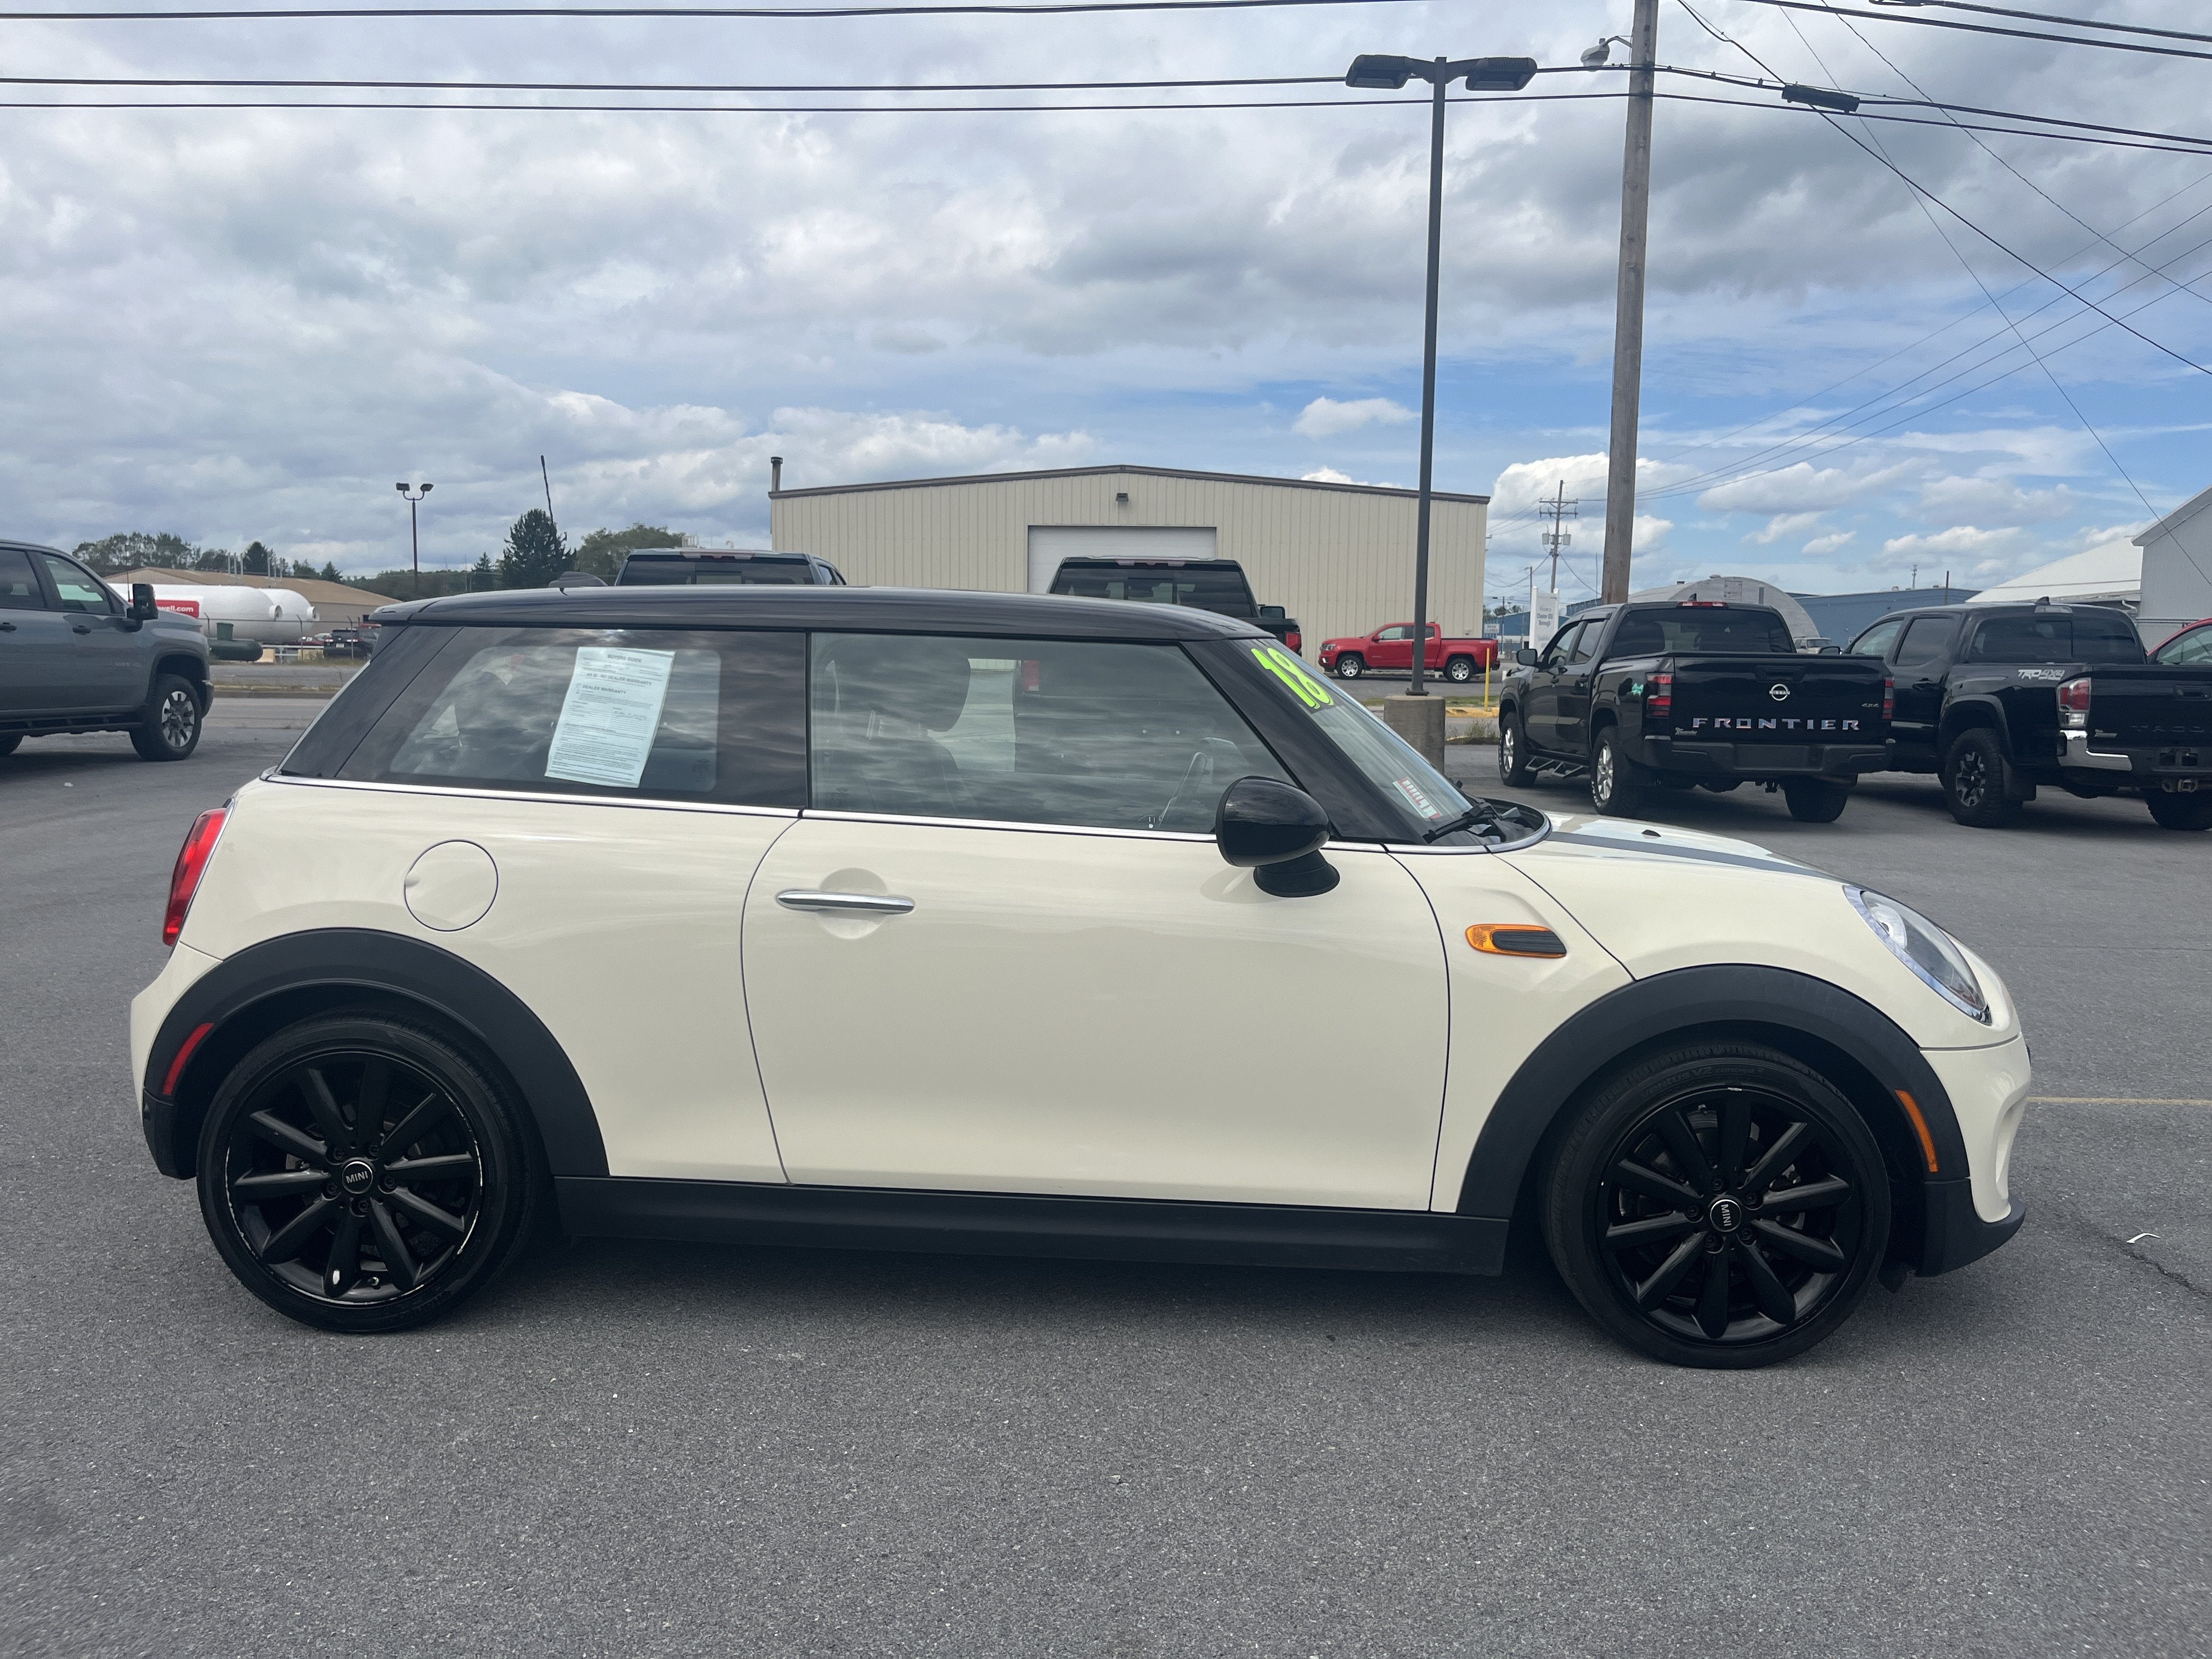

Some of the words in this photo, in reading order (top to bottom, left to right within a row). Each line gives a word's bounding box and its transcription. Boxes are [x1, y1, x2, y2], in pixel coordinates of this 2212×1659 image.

[1251, 648, 1334, 709] 18
[2018, 669, 2041, 679] TRD
[601, 686, 627, 695] WARRANTY
[1692, 718, 1860, 731] FRONTIER
[345, 1170, 369, 1184] MINI
[1720, 1204, 1732, 1226] MINI
